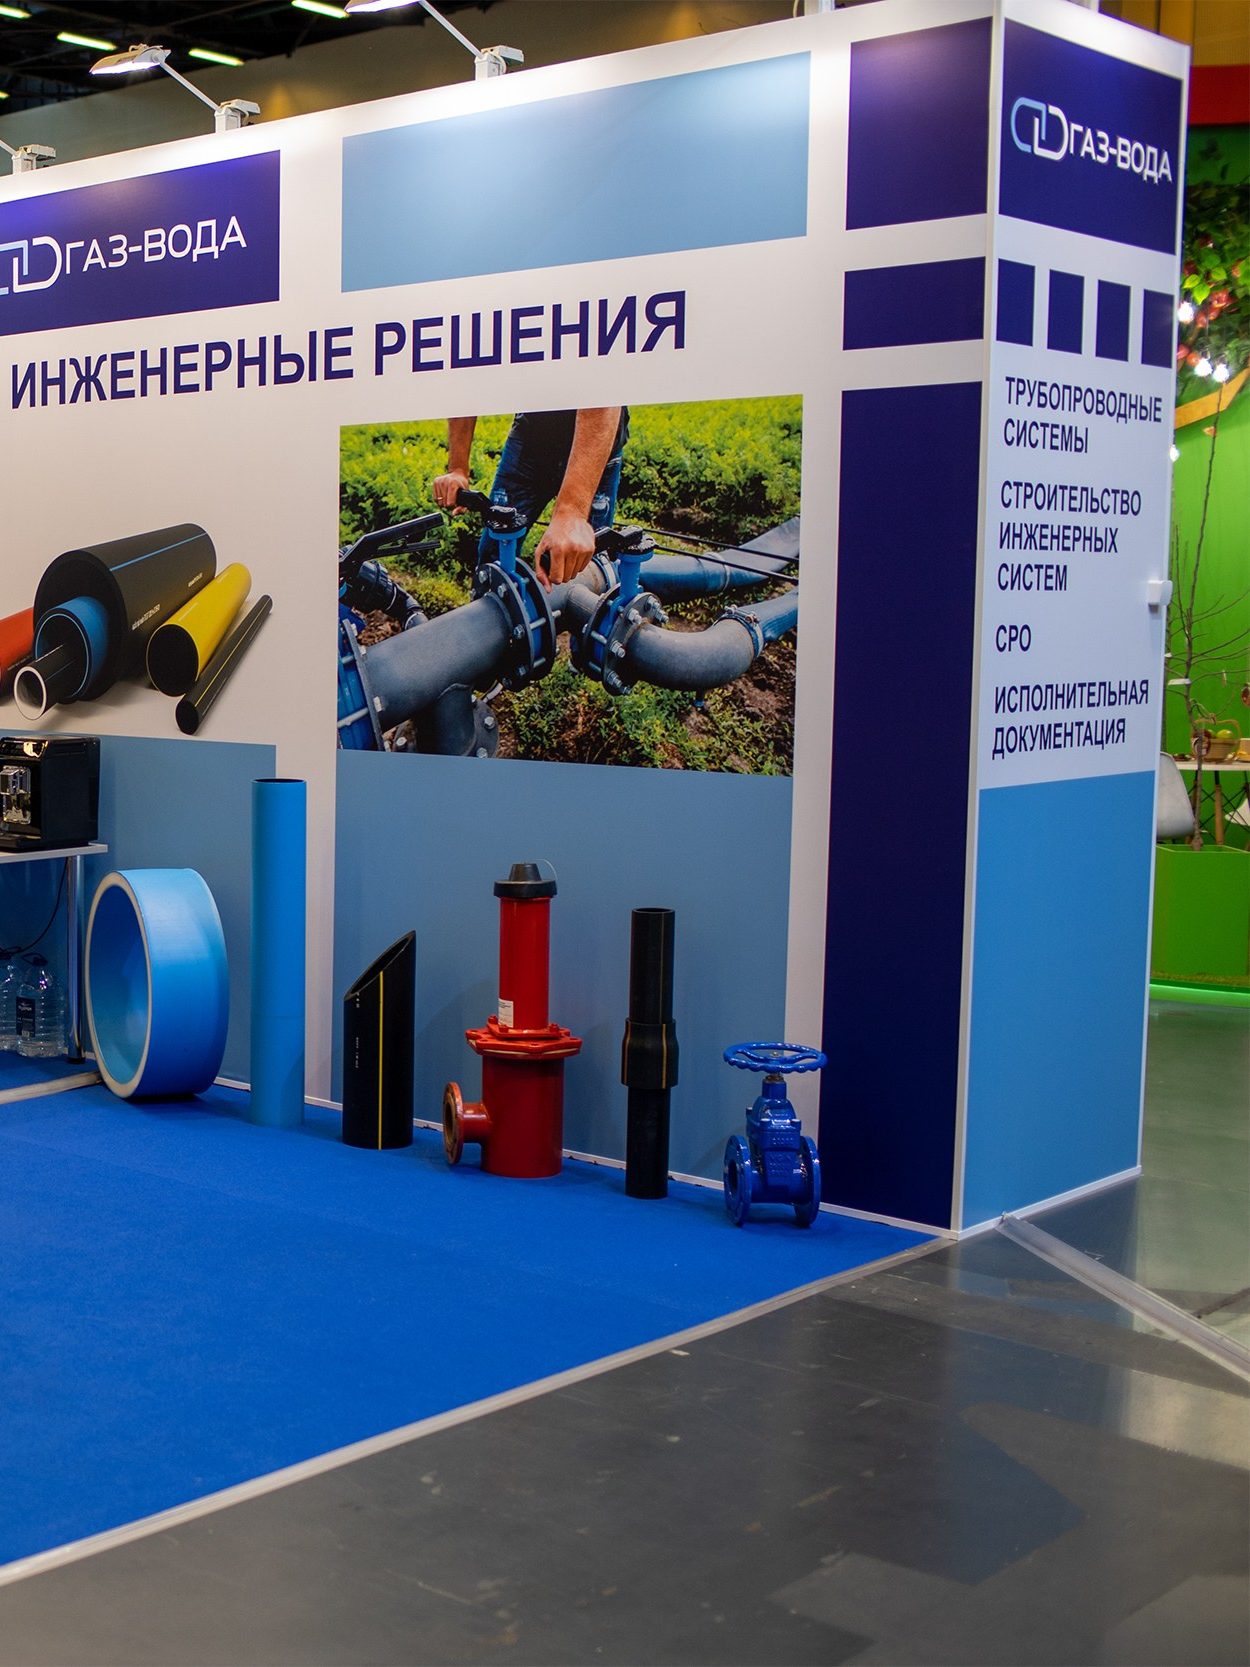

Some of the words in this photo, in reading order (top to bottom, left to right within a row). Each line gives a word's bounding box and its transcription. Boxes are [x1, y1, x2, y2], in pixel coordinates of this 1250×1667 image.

[1069, 120, 1172, 183] ГАЗ-ВОДА
[65, 215, 247, 275] ГАЗ-ВОДА
[11, 324, 354, 410] ИНЖЕНЕРНЫЕ
[374, 291, 686, 376] РЕШЕНИЯ
[1005, 377, 1163, 424] ТРУБОПРОВОДНЫЕ
[1003, 418, 1089, 454] СИСТЕМЫ
[1000, 480, 1142, 517] СТРОИТЕЛЬСТВО
[999, 521, 1119, 554] ИНЖЕНЕРНЫХ
[997, 562, 1068, 592] СИСТЕМ
[995, 624, 1032, 653] СРО
[994, 679, 1149, 714] ИСПОЛНИТЕЛЬНАЯ
[991, 717, 1126, 761] ДОКУМЕНТАЦИЯ
